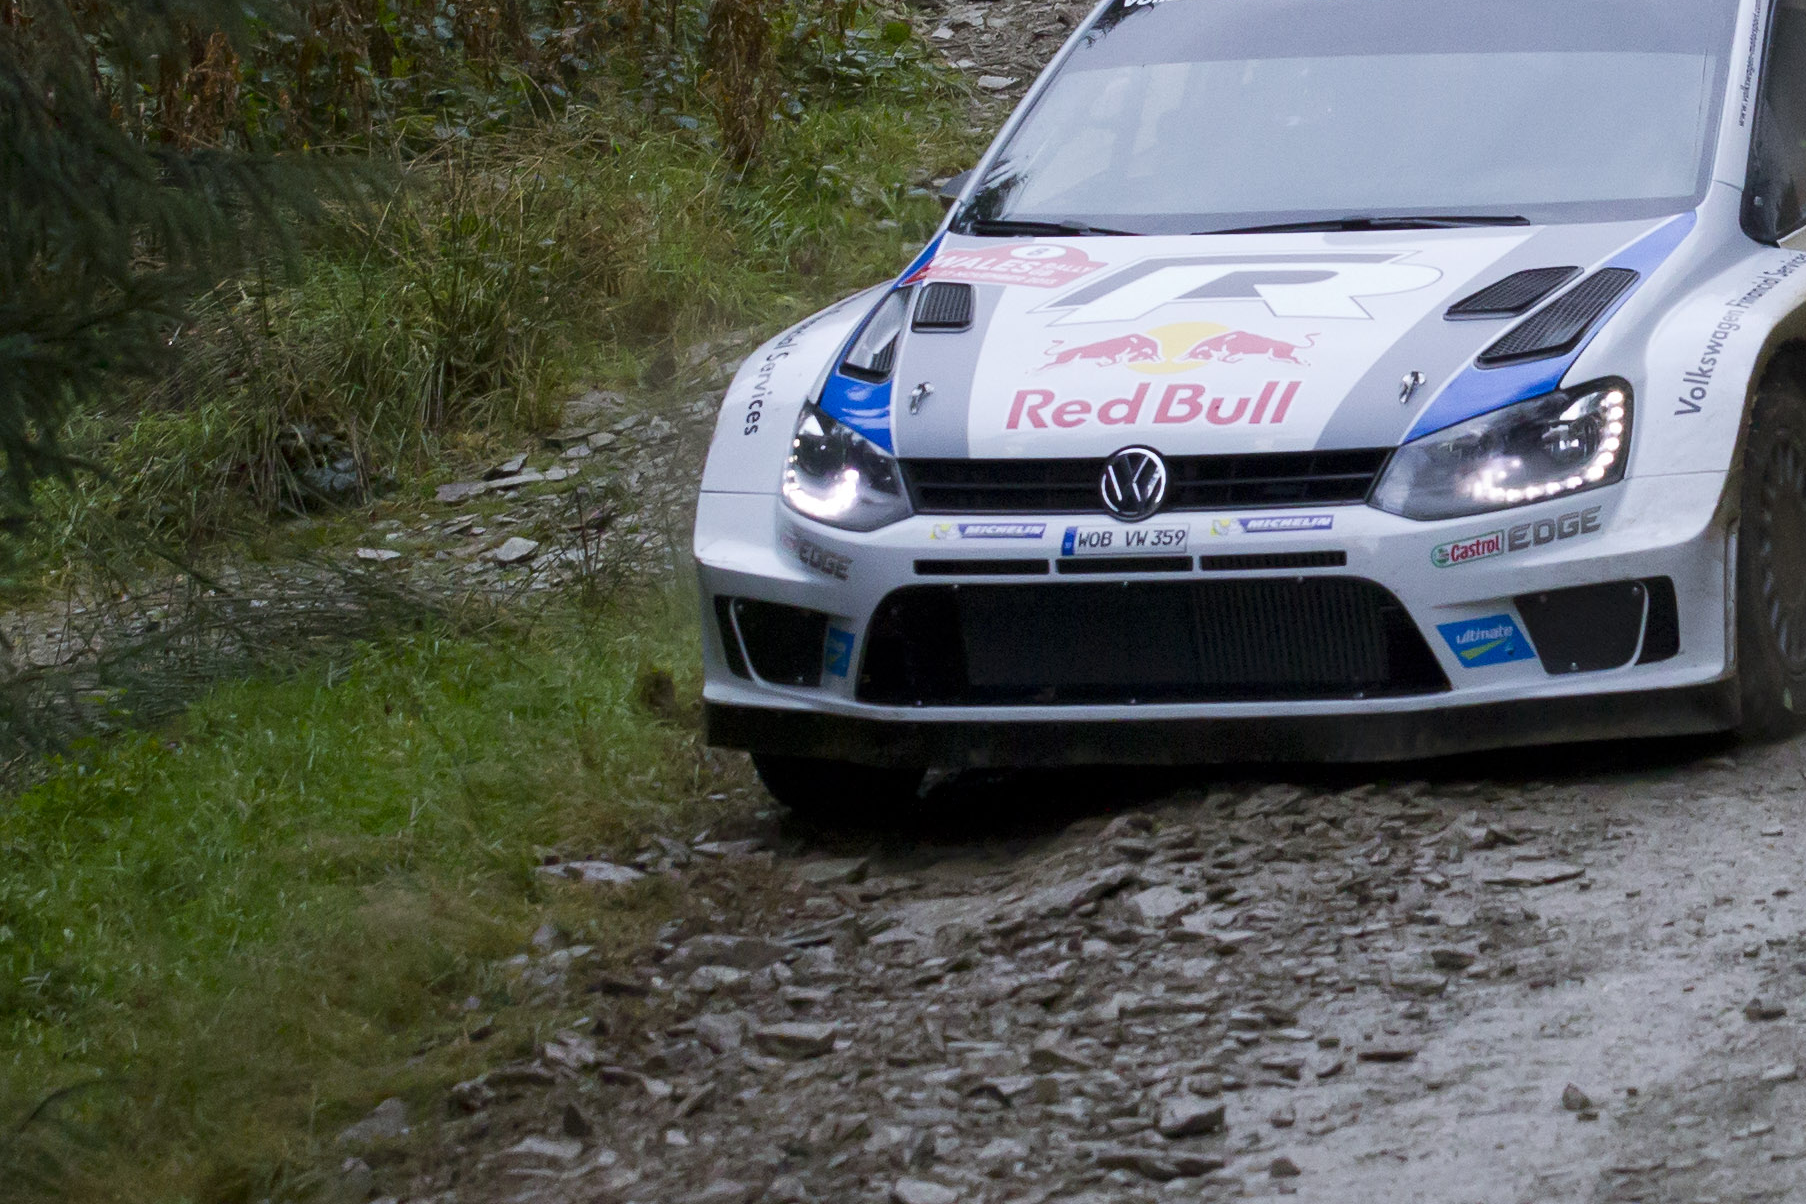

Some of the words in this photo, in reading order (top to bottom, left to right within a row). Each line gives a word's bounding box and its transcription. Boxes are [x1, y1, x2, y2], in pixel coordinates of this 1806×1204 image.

[931, 255, 1042, 274] WALES
[1674, 309, 1746, 416] Volkswagen
[744, 351, 790, 436] Services
[1005, 382, 1147, 430] Red
[1153, 380, 1302, 425] Bull
[964, 525, 1045, 535] MICHELIN
[1247, 516, 1332, 529] MICHELIN
[1077, 531, 1113, 547] WOB
[1125, 530, 1147, 547] VW
[1151, 529, 1187, 546] 359
[1451, 534, 1500, 563] Castrol
[1508, 505, 1602, 552] EDGE
[1456, 624, 1514, 645] ultimate
